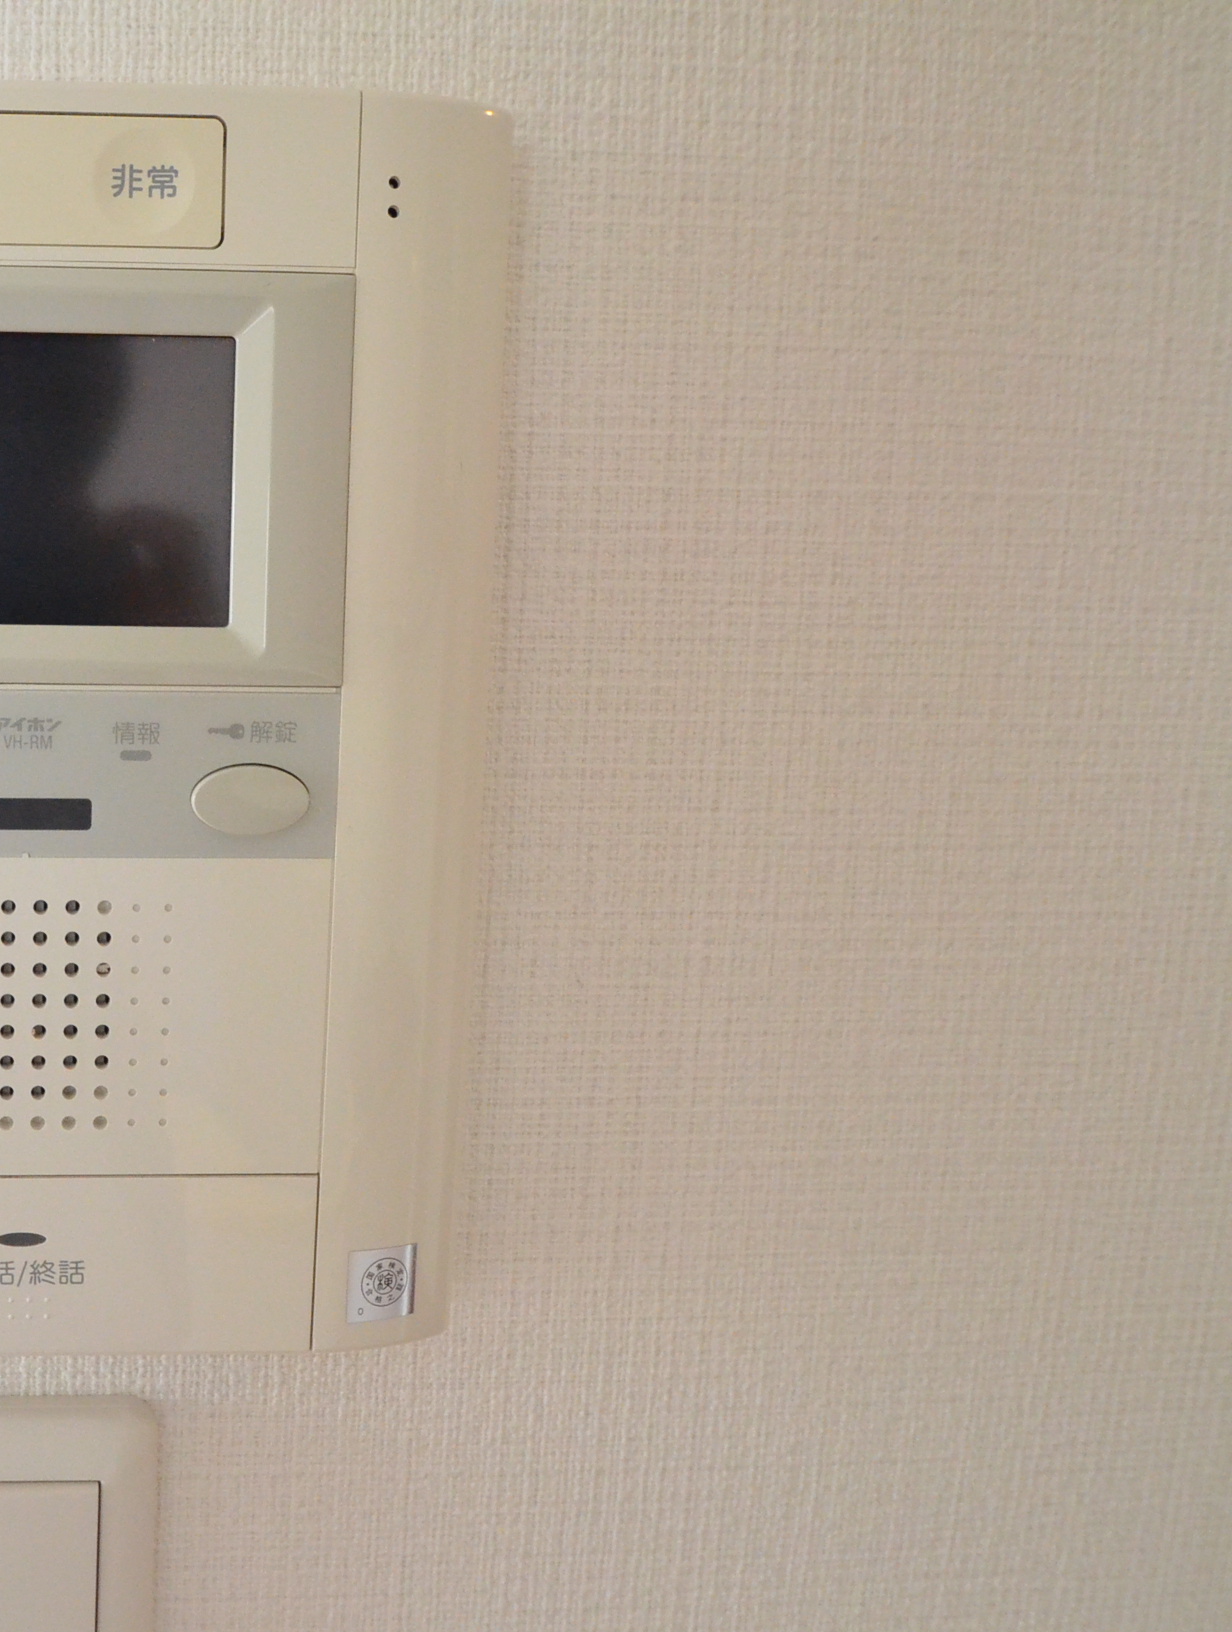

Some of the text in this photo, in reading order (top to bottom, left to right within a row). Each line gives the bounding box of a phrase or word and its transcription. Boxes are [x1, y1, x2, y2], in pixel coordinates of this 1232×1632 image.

[111, 163, 179, 199] 非常
[3, 734, 53, 749] VH-RM
[112, 721, 160, 745] 情報
[249, 720, 298, 744] 解錠
